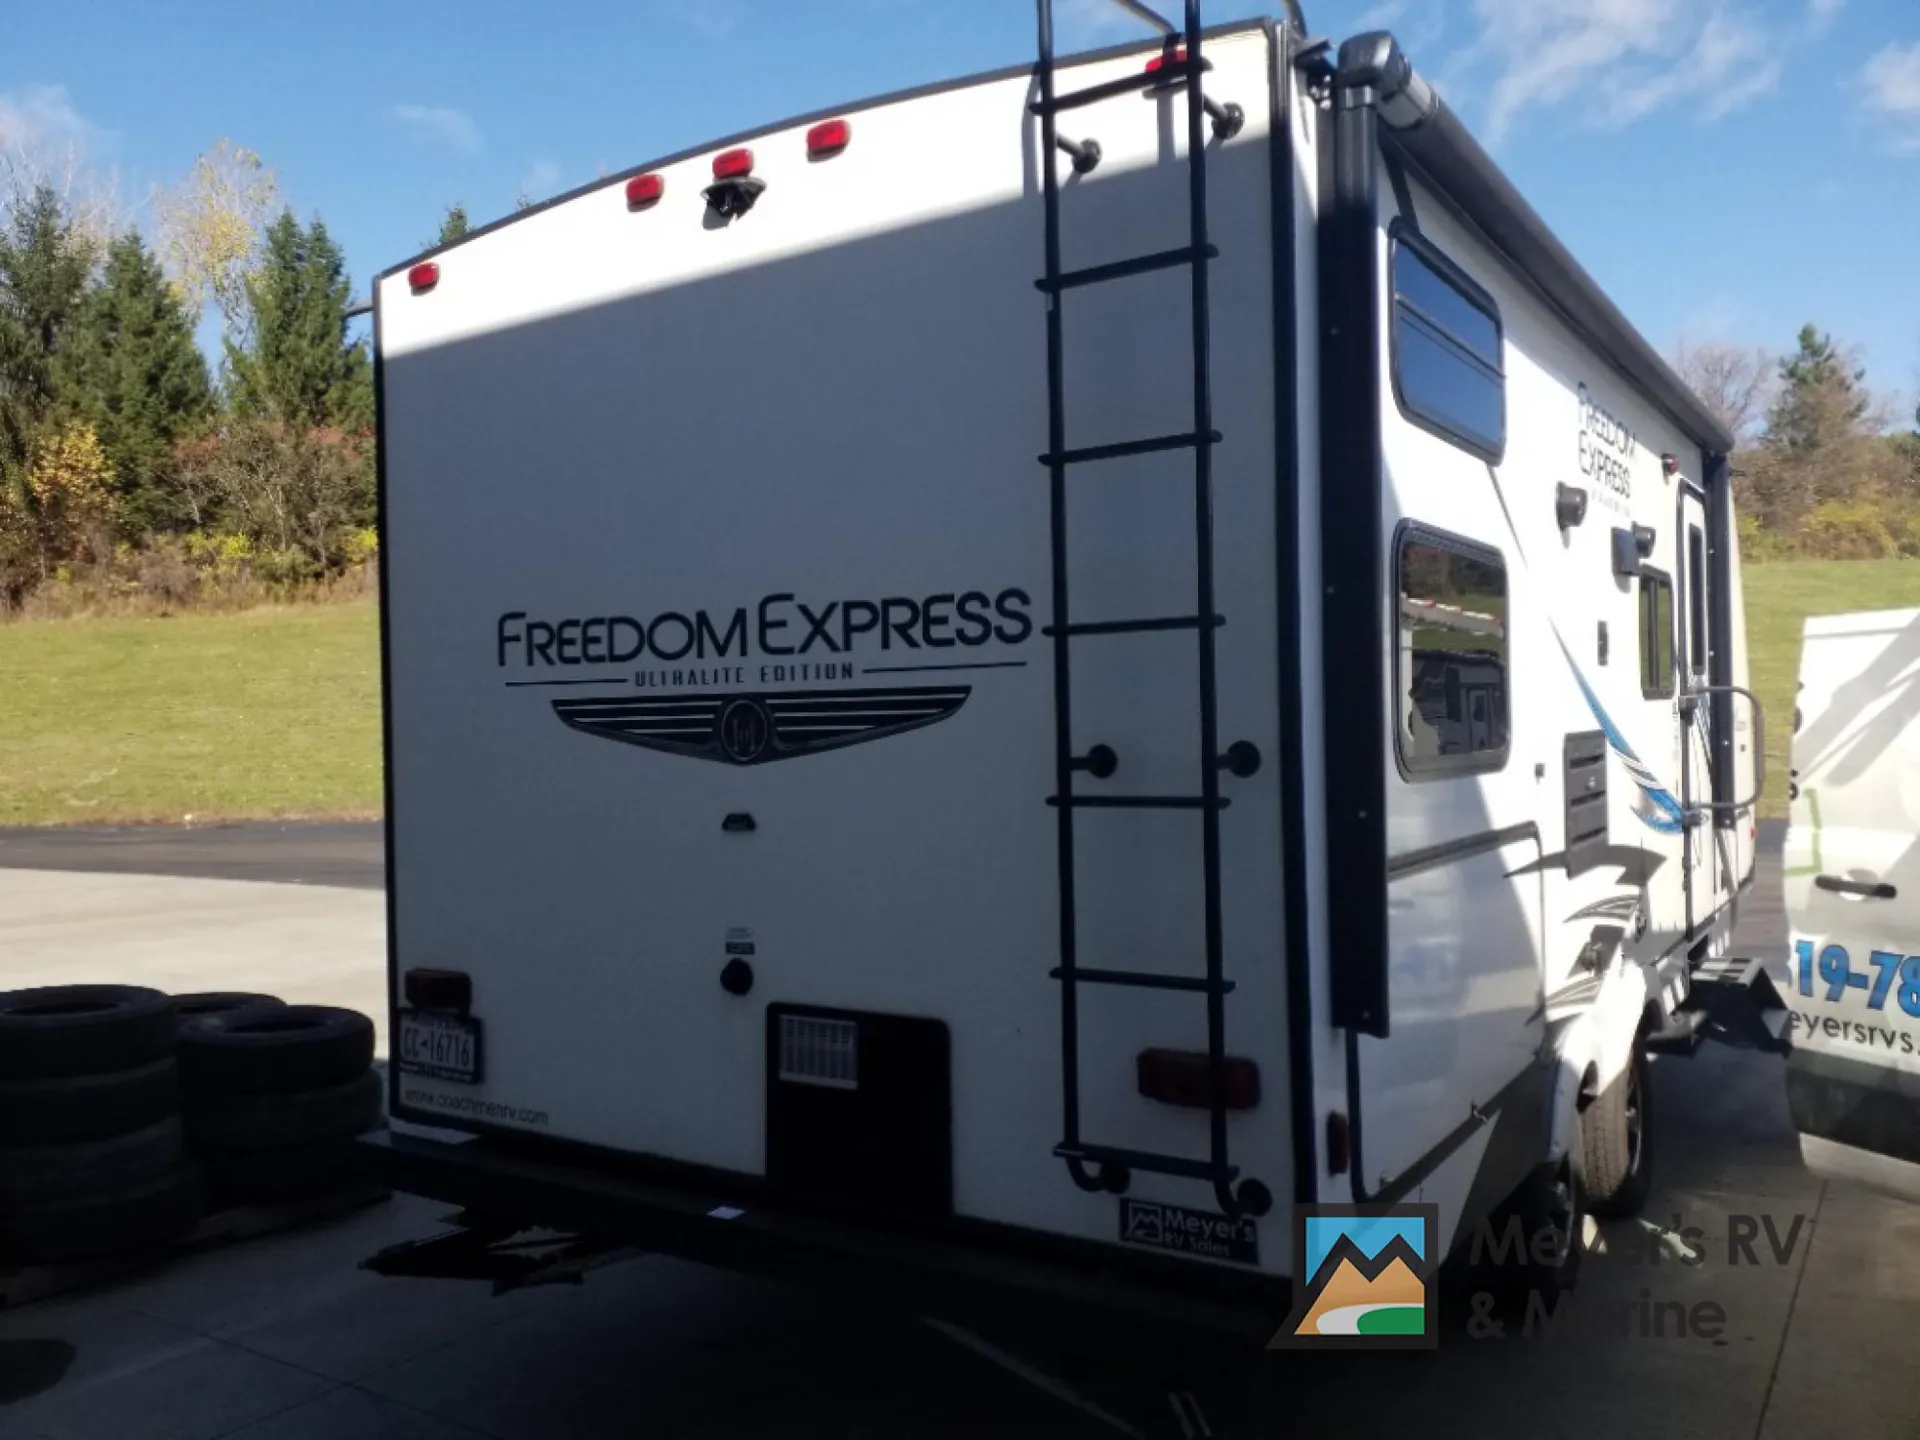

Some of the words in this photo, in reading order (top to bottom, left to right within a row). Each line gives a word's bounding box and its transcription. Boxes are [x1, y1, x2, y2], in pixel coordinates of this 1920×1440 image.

[498, 607, 748, 667] FREEDOM
[757, 588, 1033, 656] EXPRESS
[633, 666, 745, 688] ULTRALITE
[760, 661, 854, 682] EDITION
